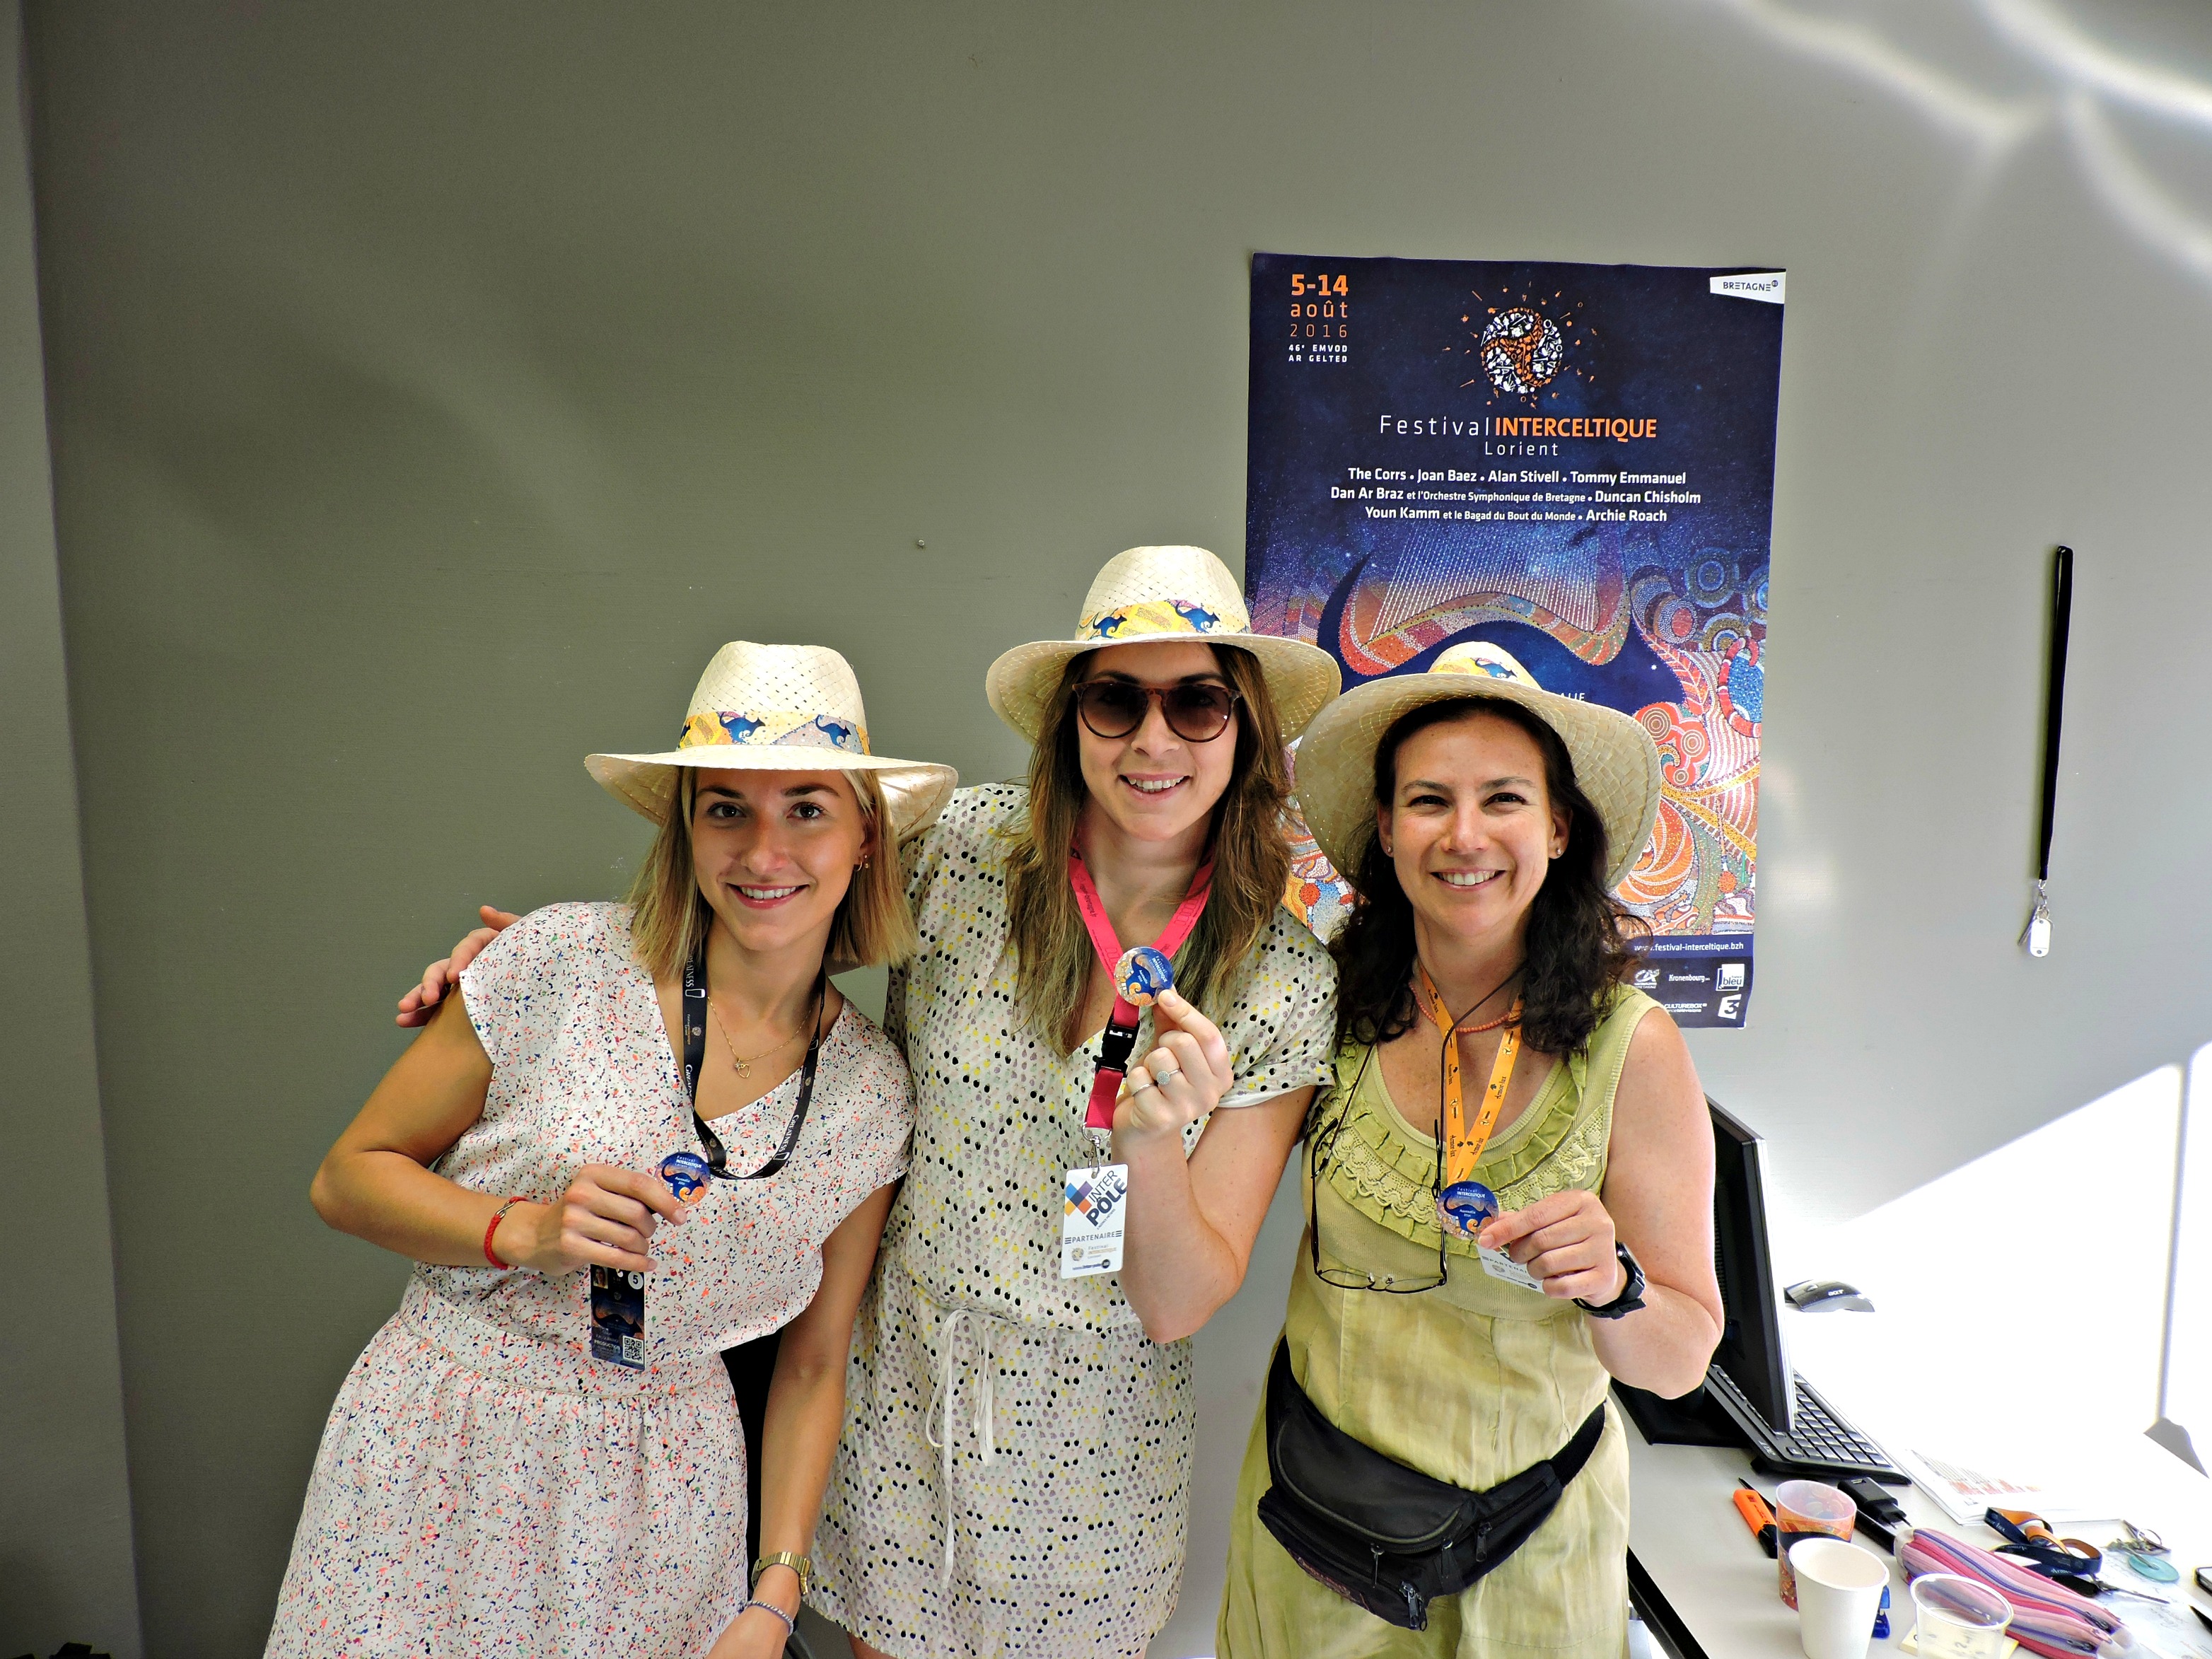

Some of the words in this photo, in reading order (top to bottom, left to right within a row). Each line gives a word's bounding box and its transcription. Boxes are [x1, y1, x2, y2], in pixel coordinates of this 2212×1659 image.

[1291, 274, 1349, 296] 5-14
[1723, 281, 1771, 291] BRETAGNE
[1291, 300, 1348, 318] août
[1290, 323, 1347, 338] 2016
[1380, 414, 1489, 436] Festival
[1495, 417, 1657, 443] INTERCELTIQUE
[1485, 441, 1559, 456] Lorient
[1348, 467, 1372, 480] The
[1375, 468, 1407, 481] Corrs
[1416, 469, 1444, 483] Joan
[1448, 470, 1477, 482] Baez
[1487, 470, 1517, 482] Alan
[1520, 470, 1559, 483] Stivell
[1570, 471, 1617, 487] Tommy
[1619, 472, 1687, 484] Emmanuel
[1331, 487, 1355, 499] Dan
[1358, 487, 1373, 499] Ar
[1376, 488, 1404, 500] Braz
[1407, 491, 1416, 500] et
[1418, 491, 1466, 501] l'Orchestre
[1468, 491, 1530, 503] Symphonique
[1532, 493, 1543, 501] de
[1545, 493, 1585, 504] Bretagne
[1595, 491, 1641, 503] Duncan
[1644, 491, 1701, 503] Chisholm
[1366, 506, 1397, 519] Youn
[1400, 507, 1440, 519] Kamm
[1443, 511, 1453, 520] et
[1454, 511, 1462, 520] le
[1464, 511, 1491, 522] Bagad
[1494, 511, 1506, 520] du
[1507, 511, 1530, 520] Bout
[1531, 511, 1543, 520] du
[1544, 512, 1576, 520] Monde
[1585, 509, 1626, 521] Archie
[1629, 510, 1667, 522] Roach
[1668, 974, 1705, 982] Kronenbourg
[1724, 999, 1740, 1014] 3
[779, 1114, 799, 1152] GREATNESS
[1088, 1170, 1117, 1203] INTER
[1085, 1177, 1127, 1227] PÔLE
[1072, 1231, 1115, 1243] PARTENAIRE
[1489, 1259, 1527, 1274] PARTENAI
[632, 1274, 639, 1285] 5
